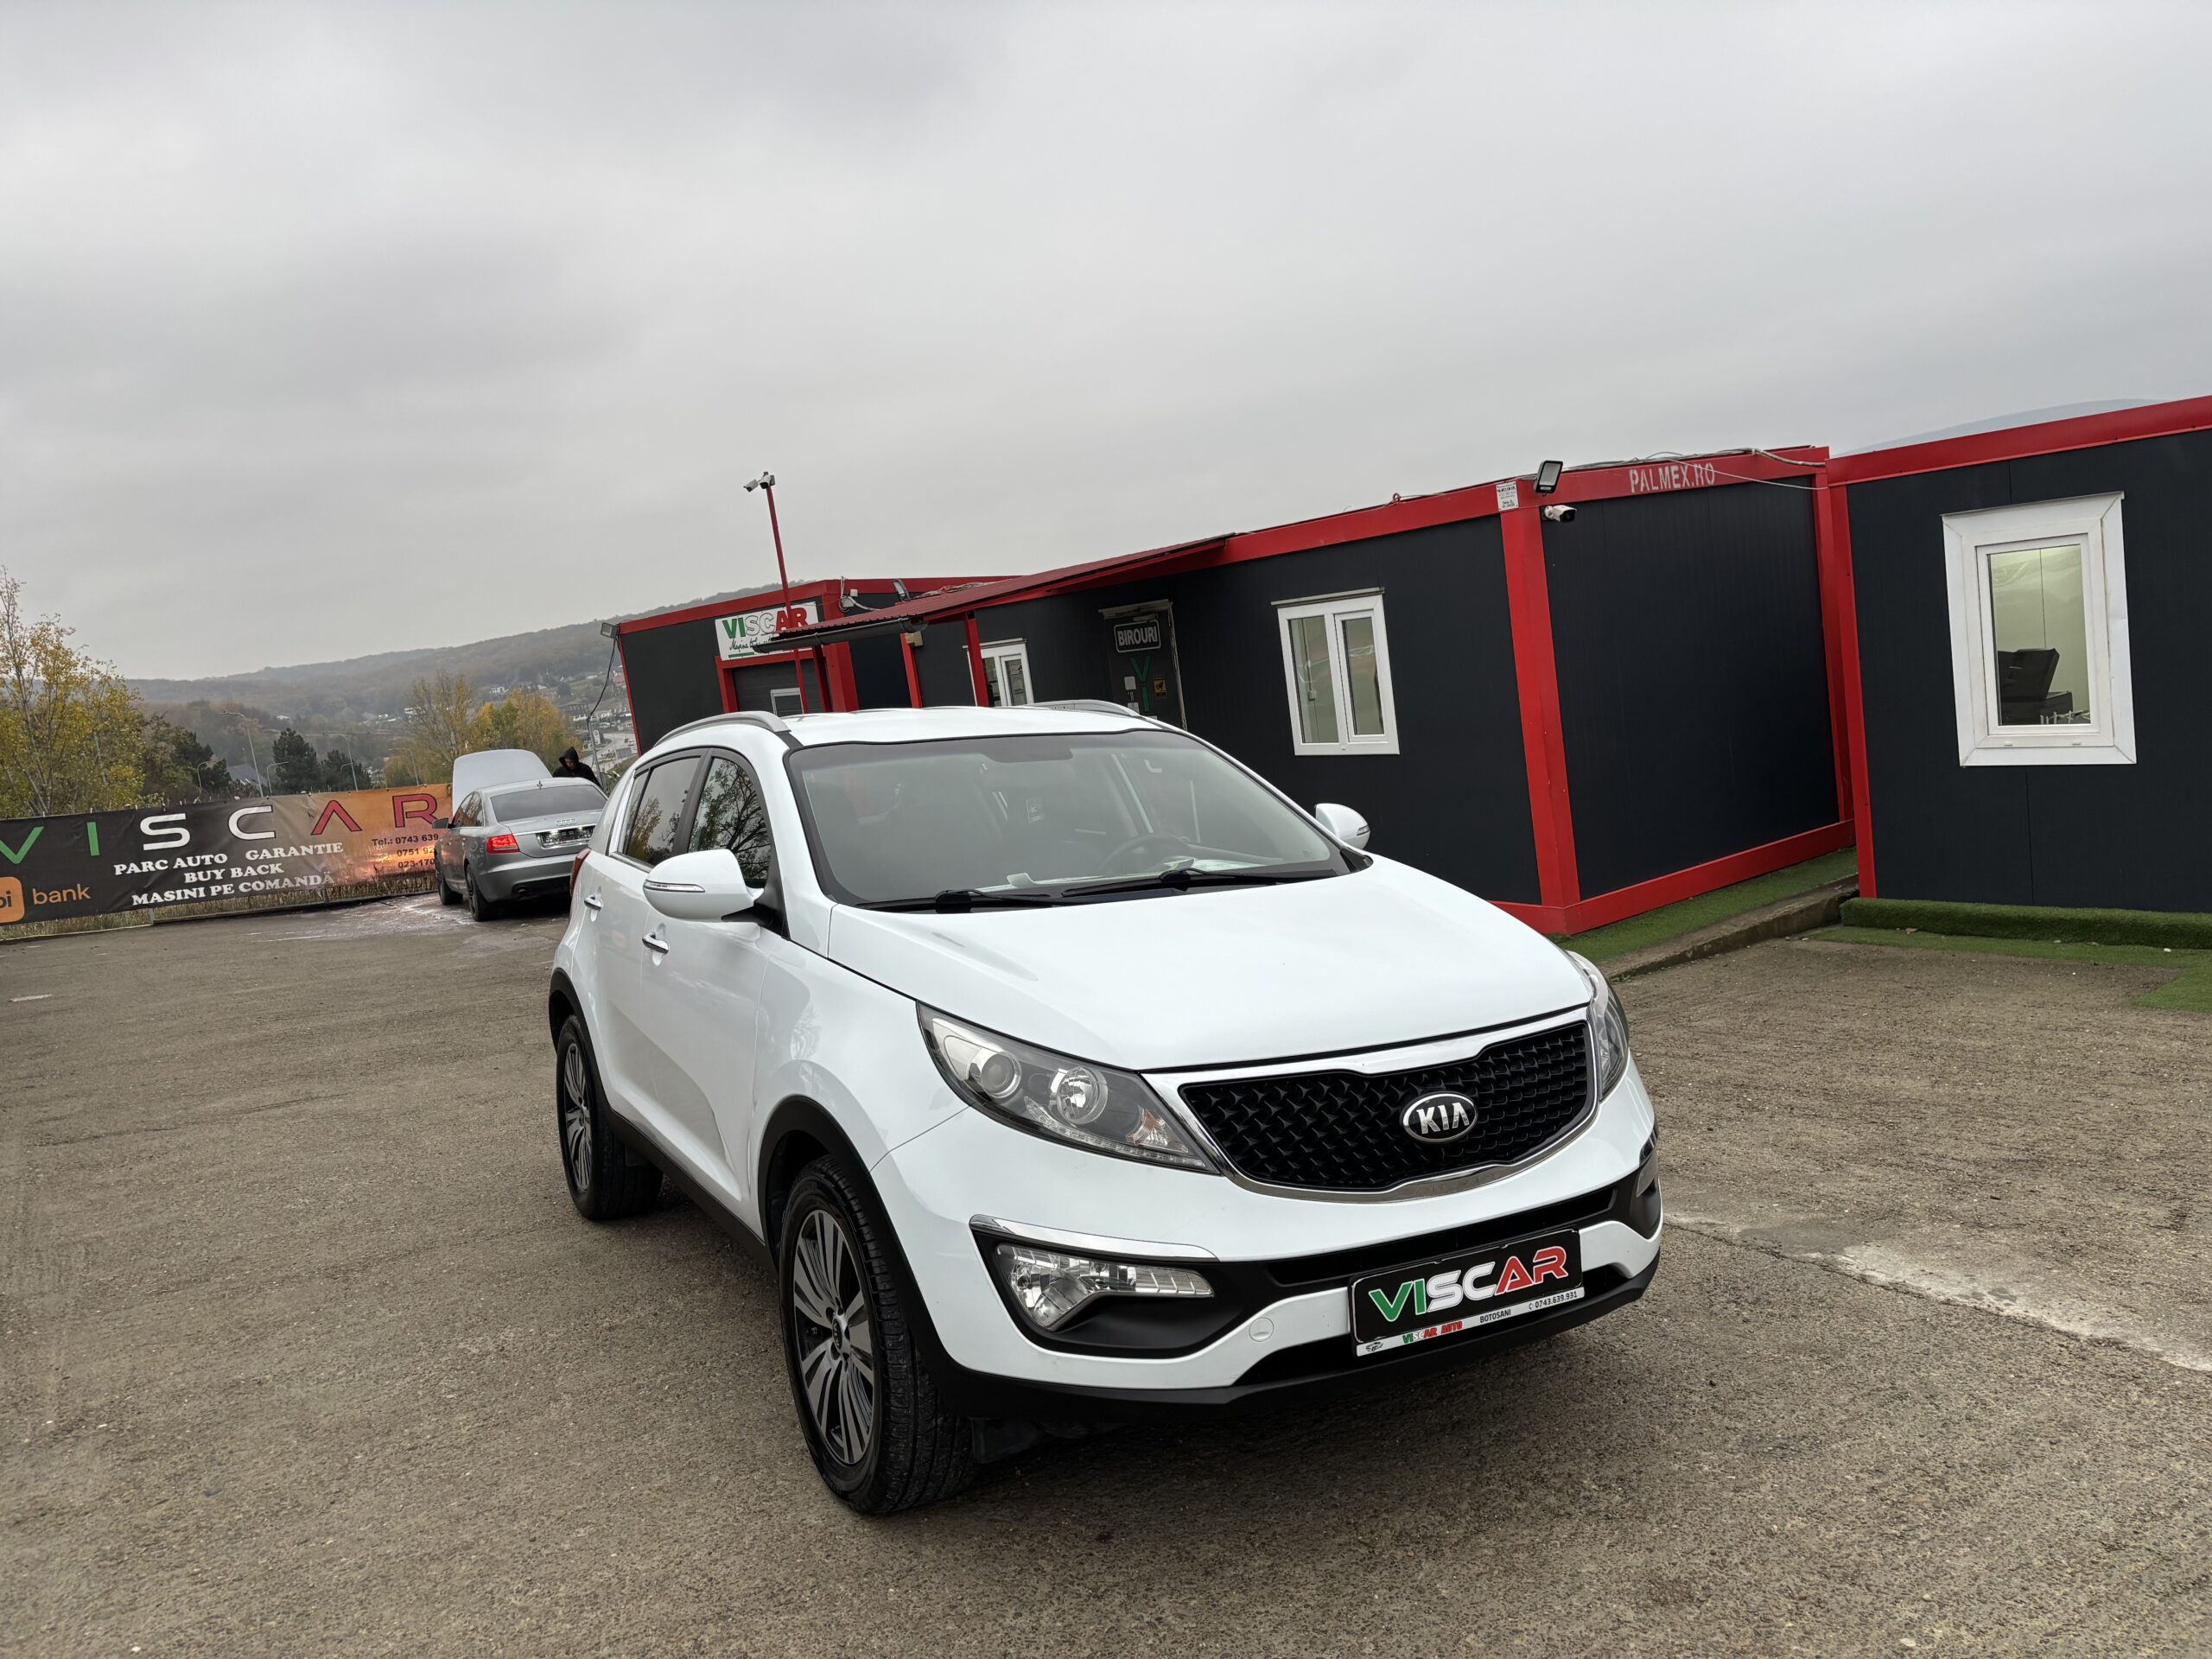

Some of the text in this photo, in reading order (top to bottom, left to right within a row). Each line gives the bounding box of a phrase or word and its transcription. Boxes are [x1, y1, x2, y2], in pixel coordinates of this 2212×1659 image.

[1629, 462, 1715, 493] PALMEX.RO
[721, 607, 809, 639] VISCAR
[1117, 626, 1158, 646] BIROURI
[0, 793, 440, 864] VISCAR
[372, 833, 439, 846] Tel.: 0743 639
[113, 842, 344, 875] PARC AUTO GARANTIE
[397, 848, 420, 857] 0751
[184, 862, 285, 884] BUY BACK
[32, 883, 92, 905] bank
[131, 887, 208, 906] MASINI
[210, 883, 235, 897] PE
[1416, 1102, 1470, 1135] KIA
[1368, 1245, 1569, 1322] VISCAR
[1402, 1290, 1578, 1344] VISCAR AUTO BOTOSANI 0743.639.931
